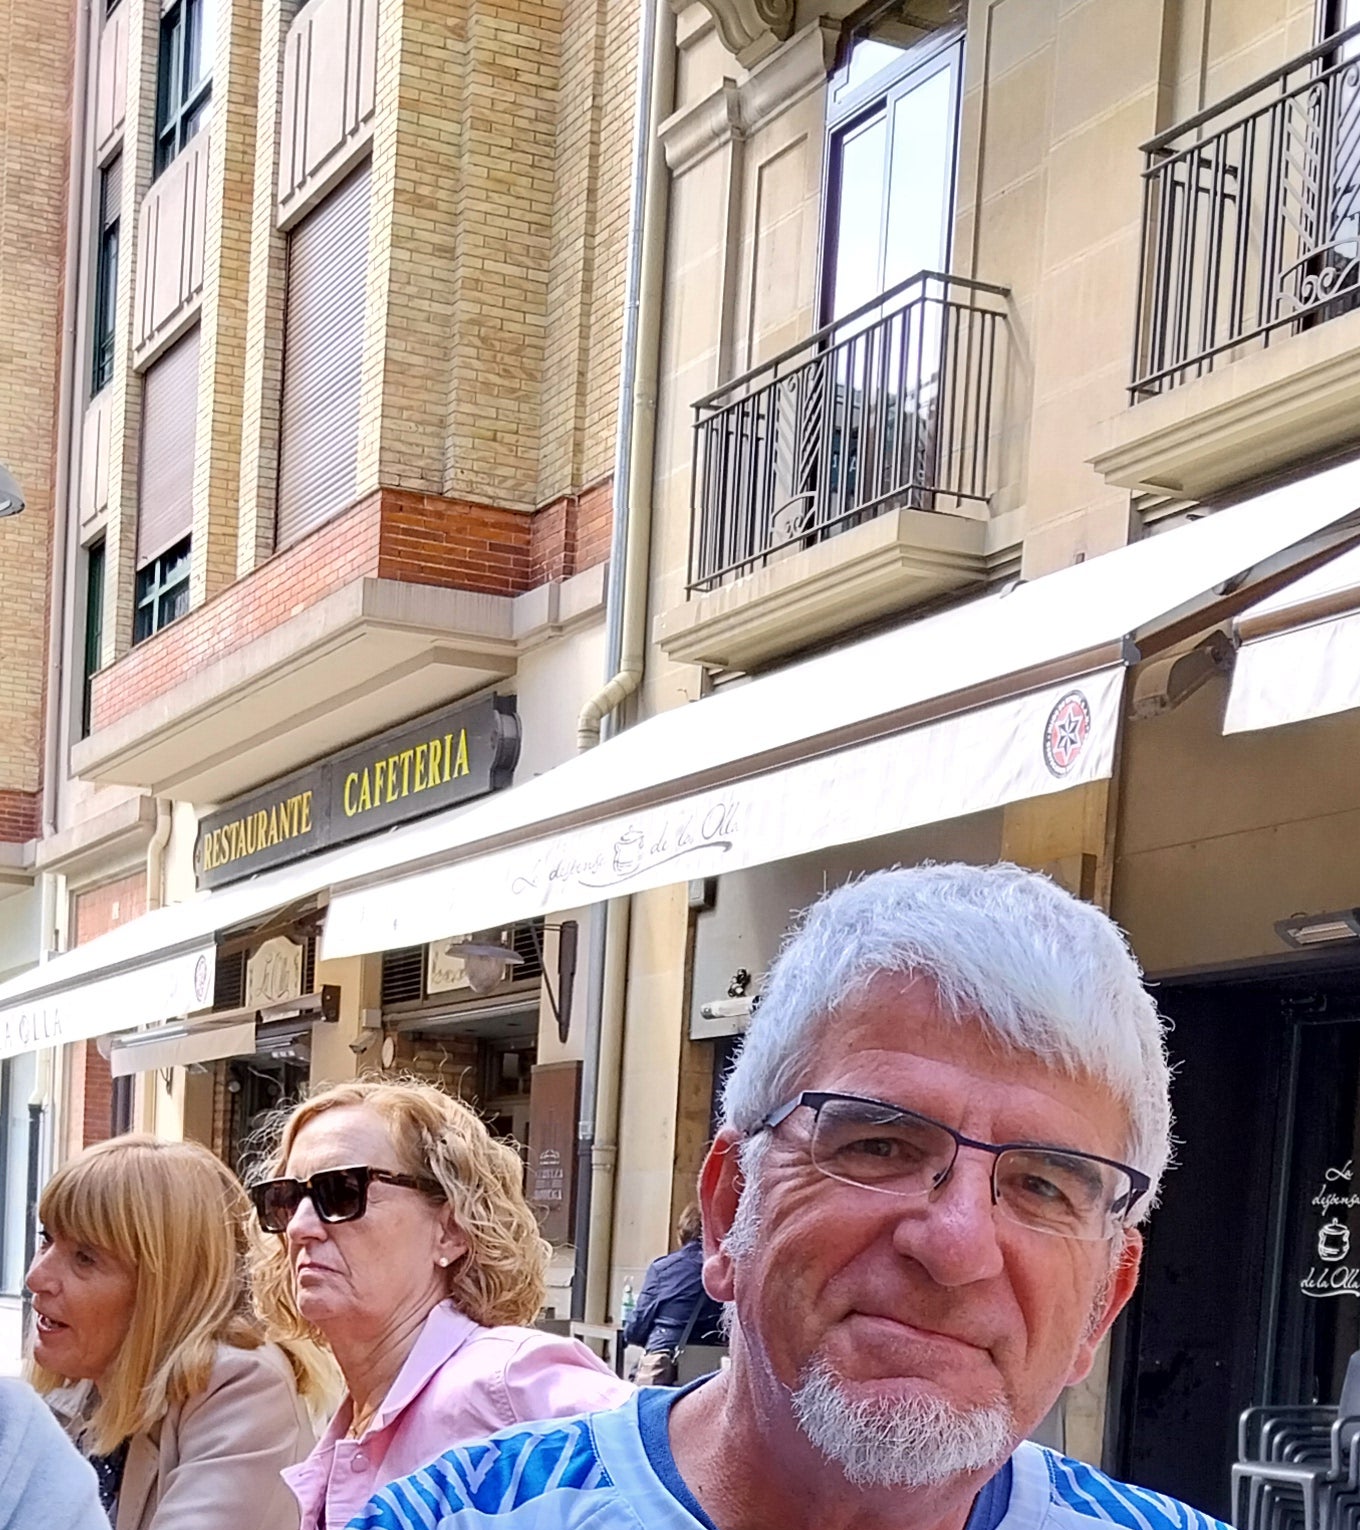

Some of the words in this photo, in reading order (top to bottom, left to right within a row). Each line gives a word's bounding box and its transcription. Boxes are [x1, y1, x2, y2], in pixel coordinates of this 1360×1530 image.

[202, 790, 313, 871] RESTAURANTE
[343, 727, 470, 818] CAFETERIA
[18, 1007, 63, 1045] OLLA
[1324, 1159, 1354, 1182] La
[1300, 1266, 1315, 1289] de
[1330, 1265, 1360, 1289] Olla
